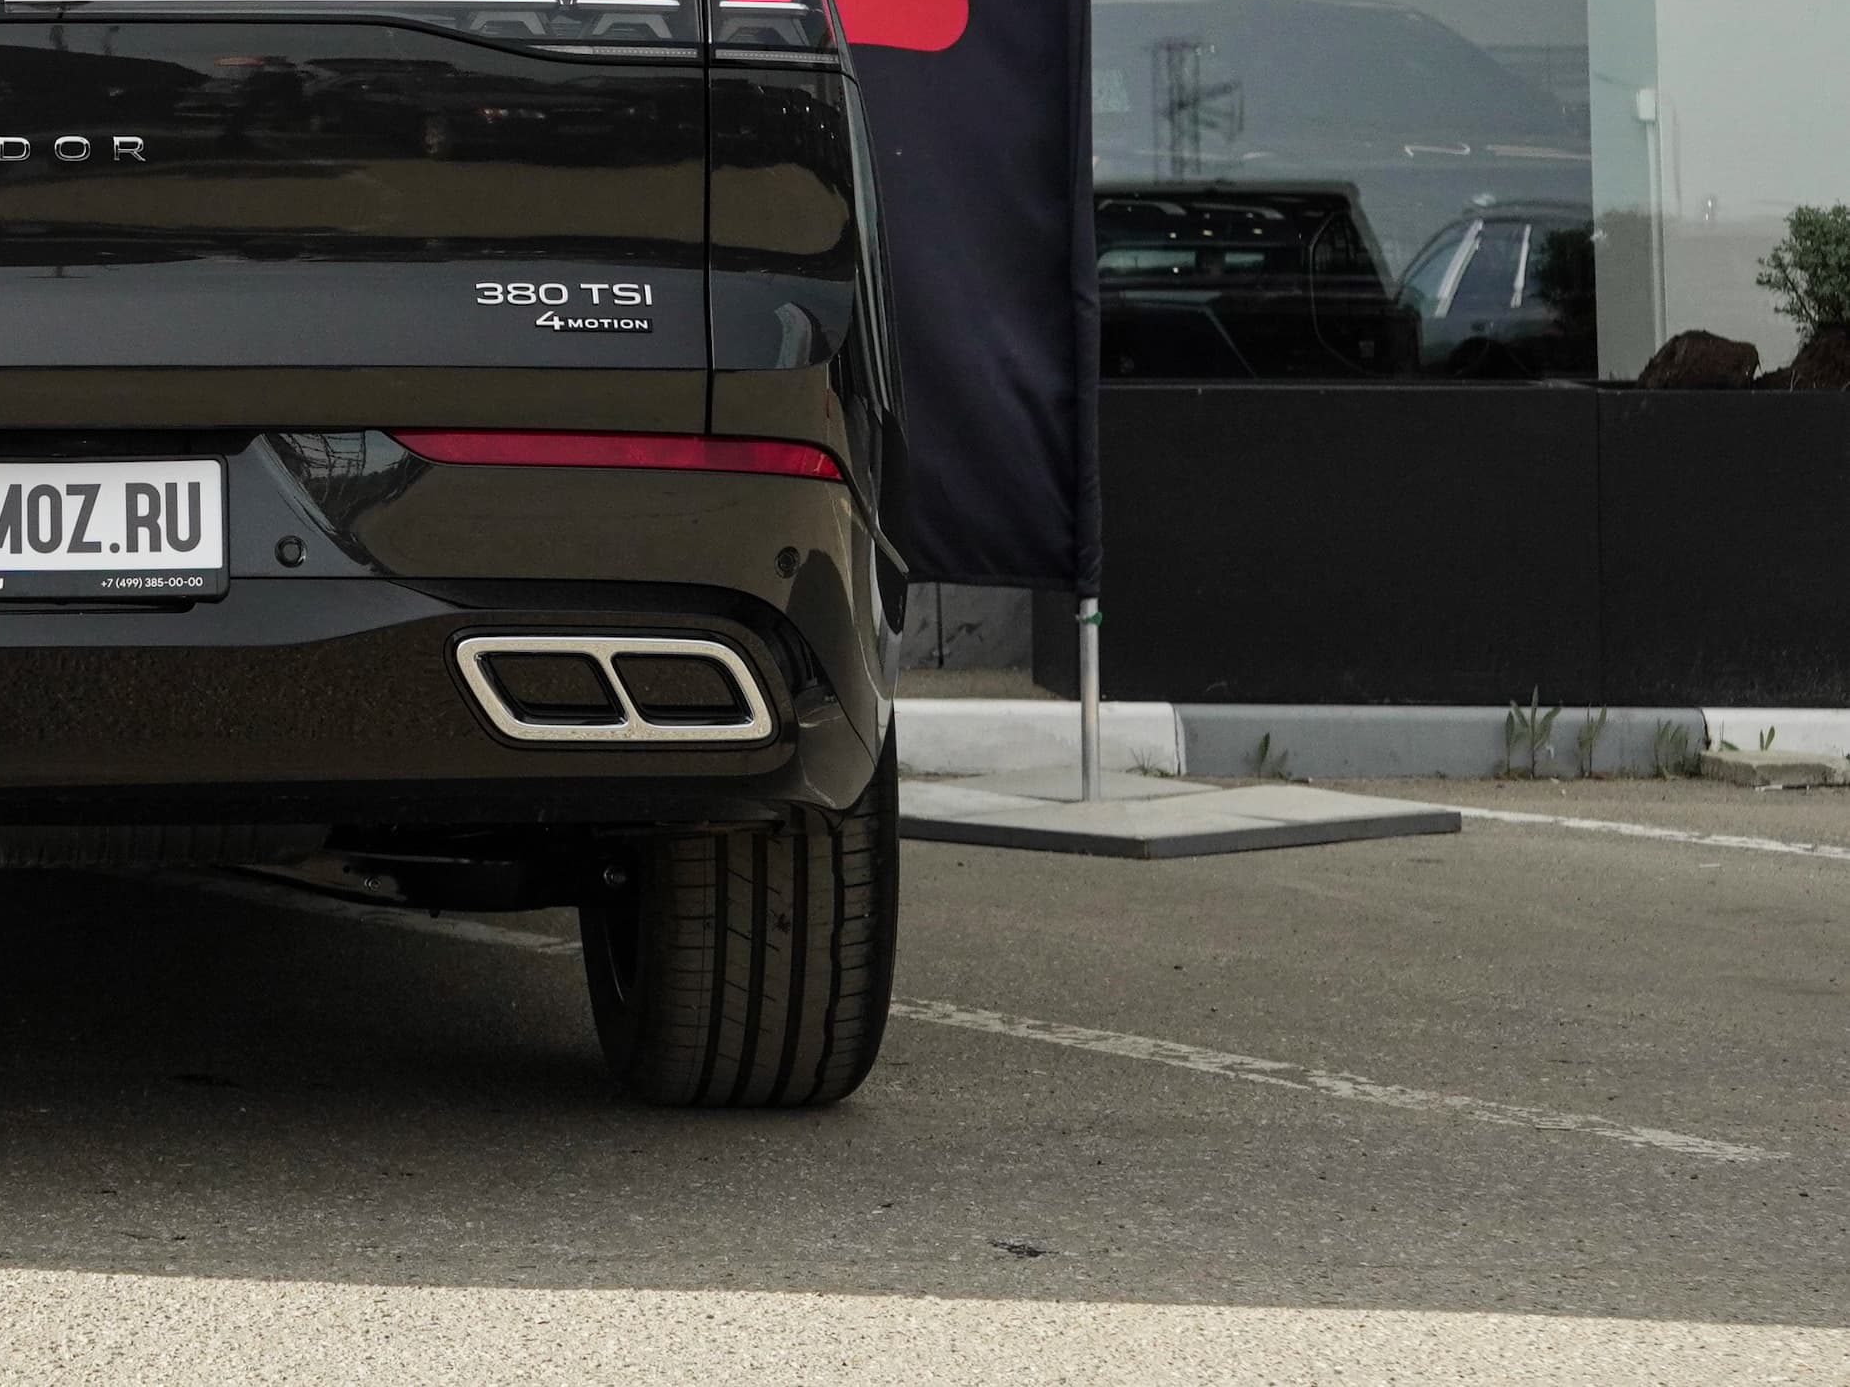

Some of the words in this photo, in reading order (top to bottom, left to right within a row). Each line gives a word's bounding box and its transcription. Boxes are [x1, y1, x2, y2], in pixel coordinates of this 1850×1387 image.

[474, 282, 569, 306] 380
[580, 283, 653, 306] TSI
[535, 310, 649, 331] 4MOTION
[101, 578, 113, 588] +7
[115, 577, 143, 589] (499)
[144, 576, 204, 588] 385-00-00
